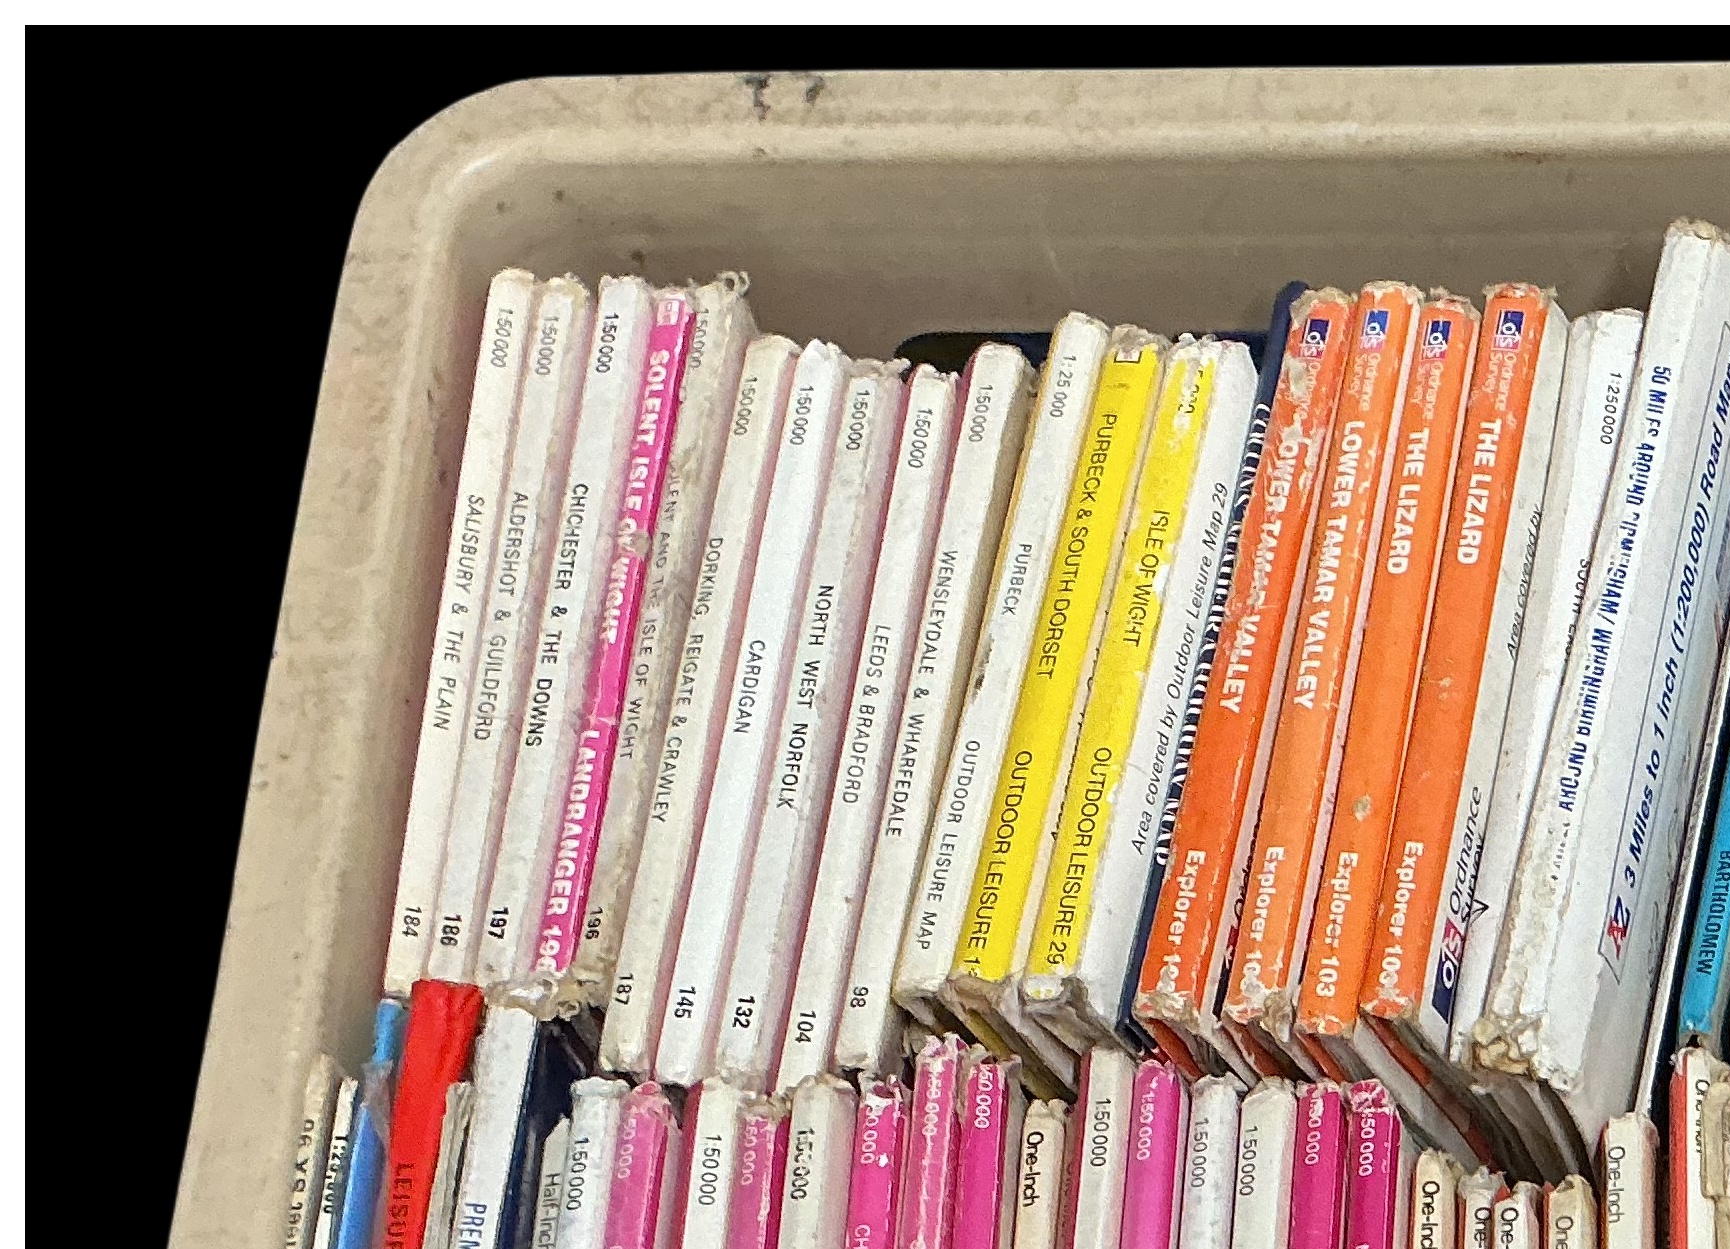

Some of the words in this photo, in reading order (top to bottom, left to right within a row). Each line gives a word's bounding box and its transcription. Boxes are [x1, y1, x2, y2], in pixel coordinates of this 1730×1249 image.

[1078, 414, 1116, 503] PURBECK
[1326, 422, 1365, 510] LOWER
[1402, 426, 1429, 480] THE
[1701, 422, 1724, 500] Road
[1074, 509, 1090, 521] &
[1202, 504, 1225, 550] Map
[1212, 482, 1227, 508] 29
[458, 494, 485, 595] SALISBURY
[555, 483, 588, 591] CHICHESTER
[1058, 527, 1088, 600] SOUTH
[1313, 515, 1347, 604] TAMAR
[1387, 484, 1420, 575] LIZARD
[451, 604, 468, 617] &
[691, 538, 724, 620] DORKING,
[1190, 555, 1214, 620] Leisure
[1670, 502, 1710, 653] (1:200,000)
[440, 630, 463, 662] THE
[550, 606, 567, 619] &
[915, 550, 958, 675] WENSLEYDALE
[1036, 601, 1069, 680] DORSET
[540, 630, 562, 665] THE
[676, 635, 704, 706] REIGATE
[1167, 624, 1198, 699] Outdoor
[1296, 610, 1332, 711] VALLEY
[432, 677, 456, 731] PLAIN
[524, 679, 553, 747] DOWNS
[734, 640, 766, 734] CARDIGAN
[914, 688, 928, 698] &
[1158, 705, 1180, 735] by
[1656, 657, 1680, 720] inch
[671, 716, 686, 727] &
[1652, 722, 1670, 742] 1
[652, 737, 682, 825] CRAWLEY
[886, 714, 924, 836] WHARFEDALE
[1145, 733, 1172, 806] covered
[1648, 751, 1661, 780] to
[995, 752, 1032, 851] OUTDOOR
[1132, 812, 1152, 855] Area
[1628, 786, 1653, 862] Miles
[969, 860, 1007, 948] LEISURE
[1328, 852, 1360, 945] Explorer
[1624, 865, 1638, 888] 3
[402, 906, 422, 938] 184
[488, 907, 510, 940] 197
[612, 974, 632, 1005] 187
[674, 986, 696, 1019] 145
[850, 986, 869, 1009] 98
[1315, 955, 1338, 998] 103
[1022, 1131, 1044, 1208] One-Inch
